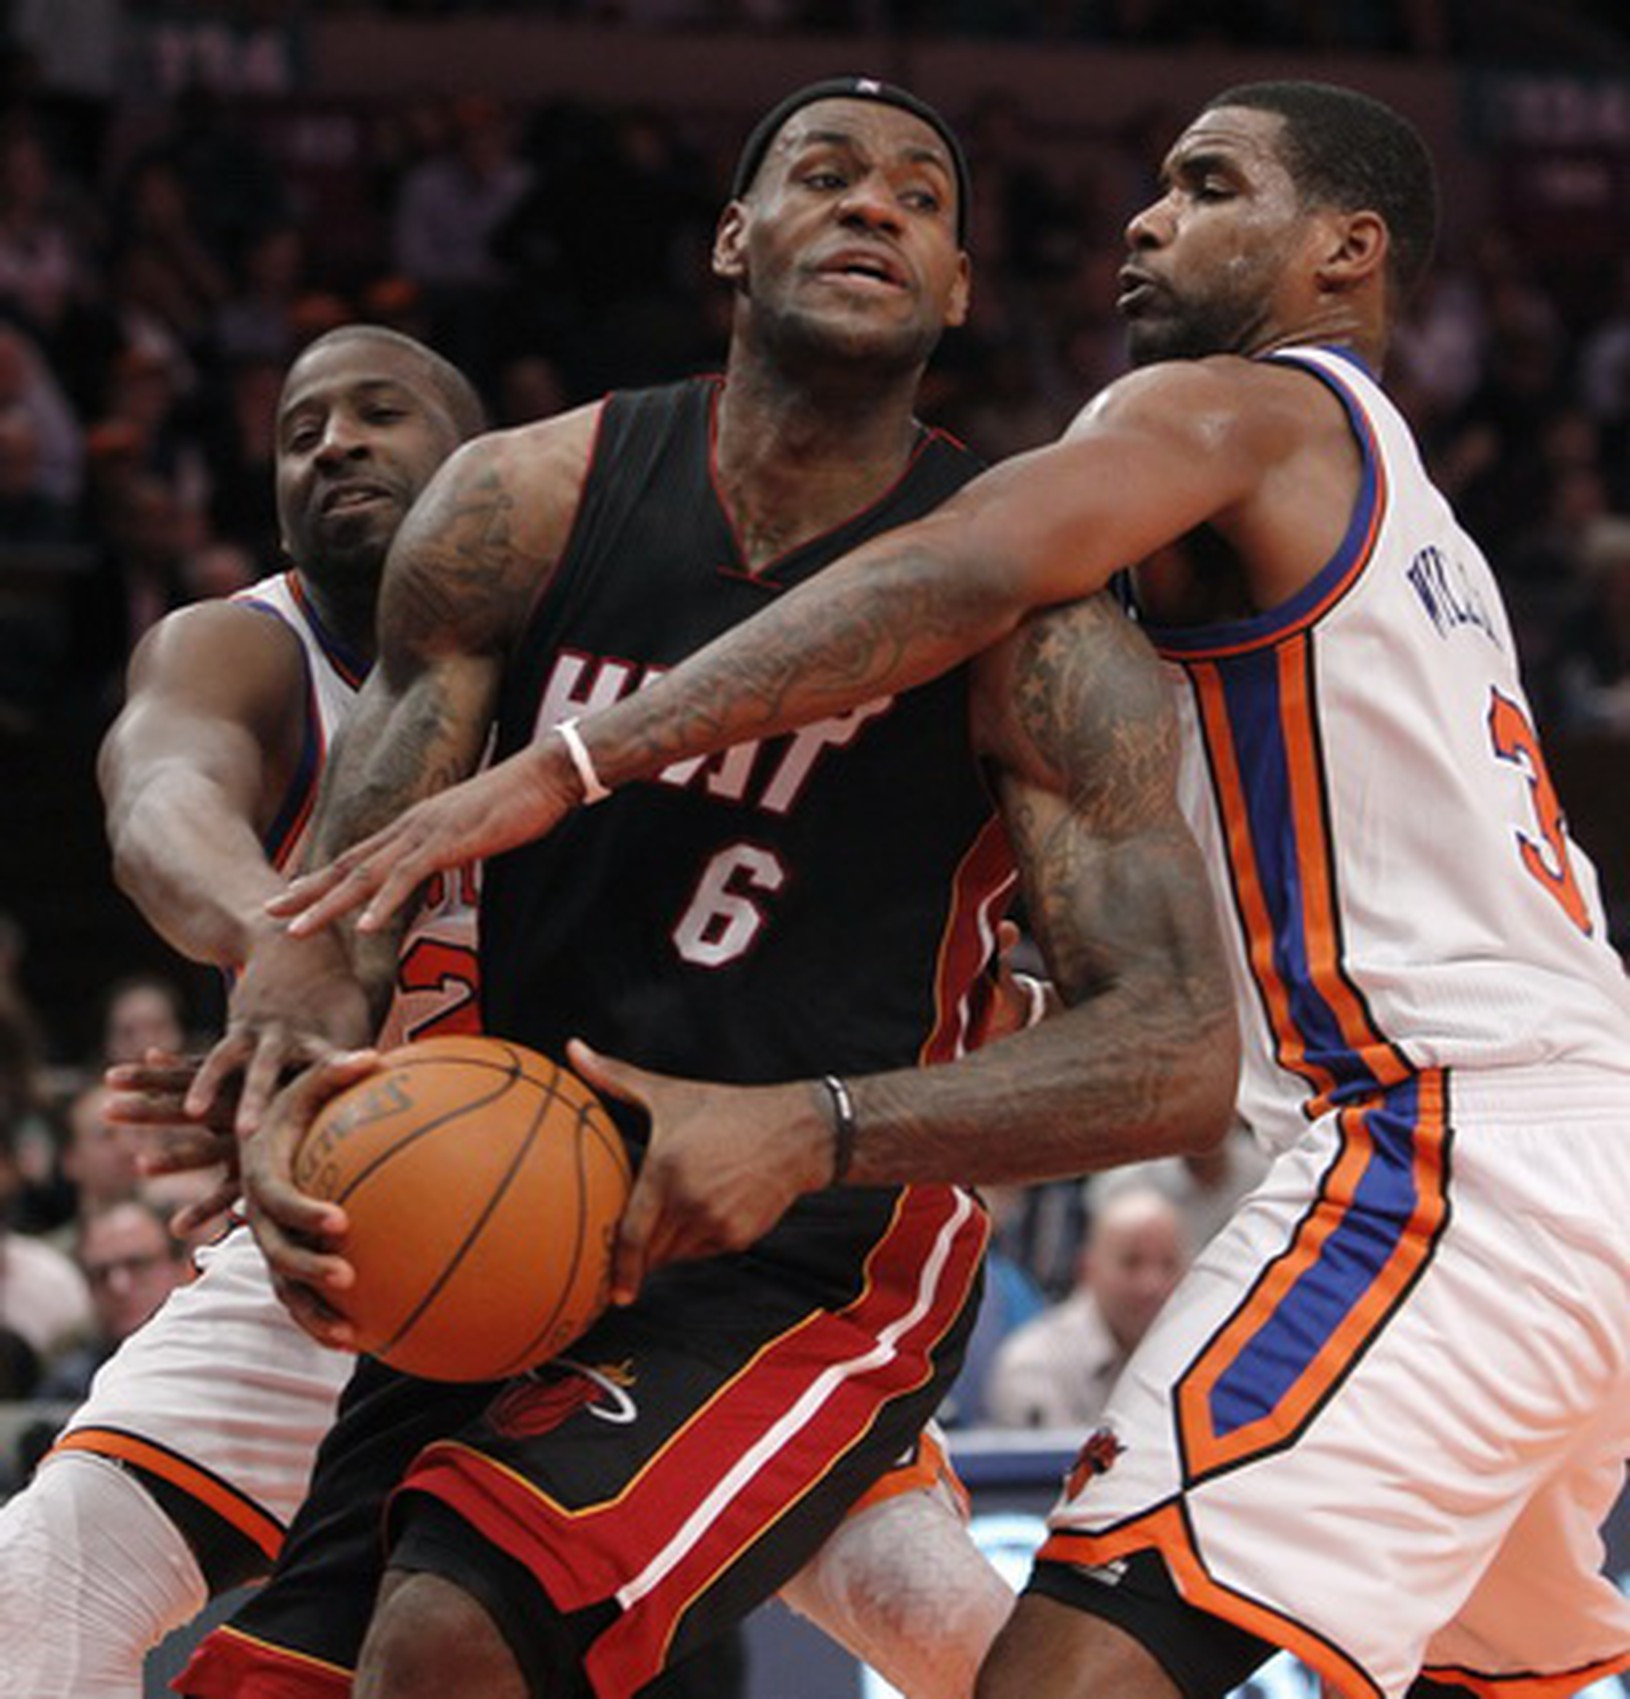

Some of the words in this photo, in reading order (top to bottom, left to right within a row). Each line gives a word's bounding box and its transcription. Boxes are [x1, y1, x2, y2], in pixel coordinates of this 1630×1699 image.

[533, 649, 893, 813] HT
[673, 842, 785, 968] 6
[398, 936, 482, 1043] 2
